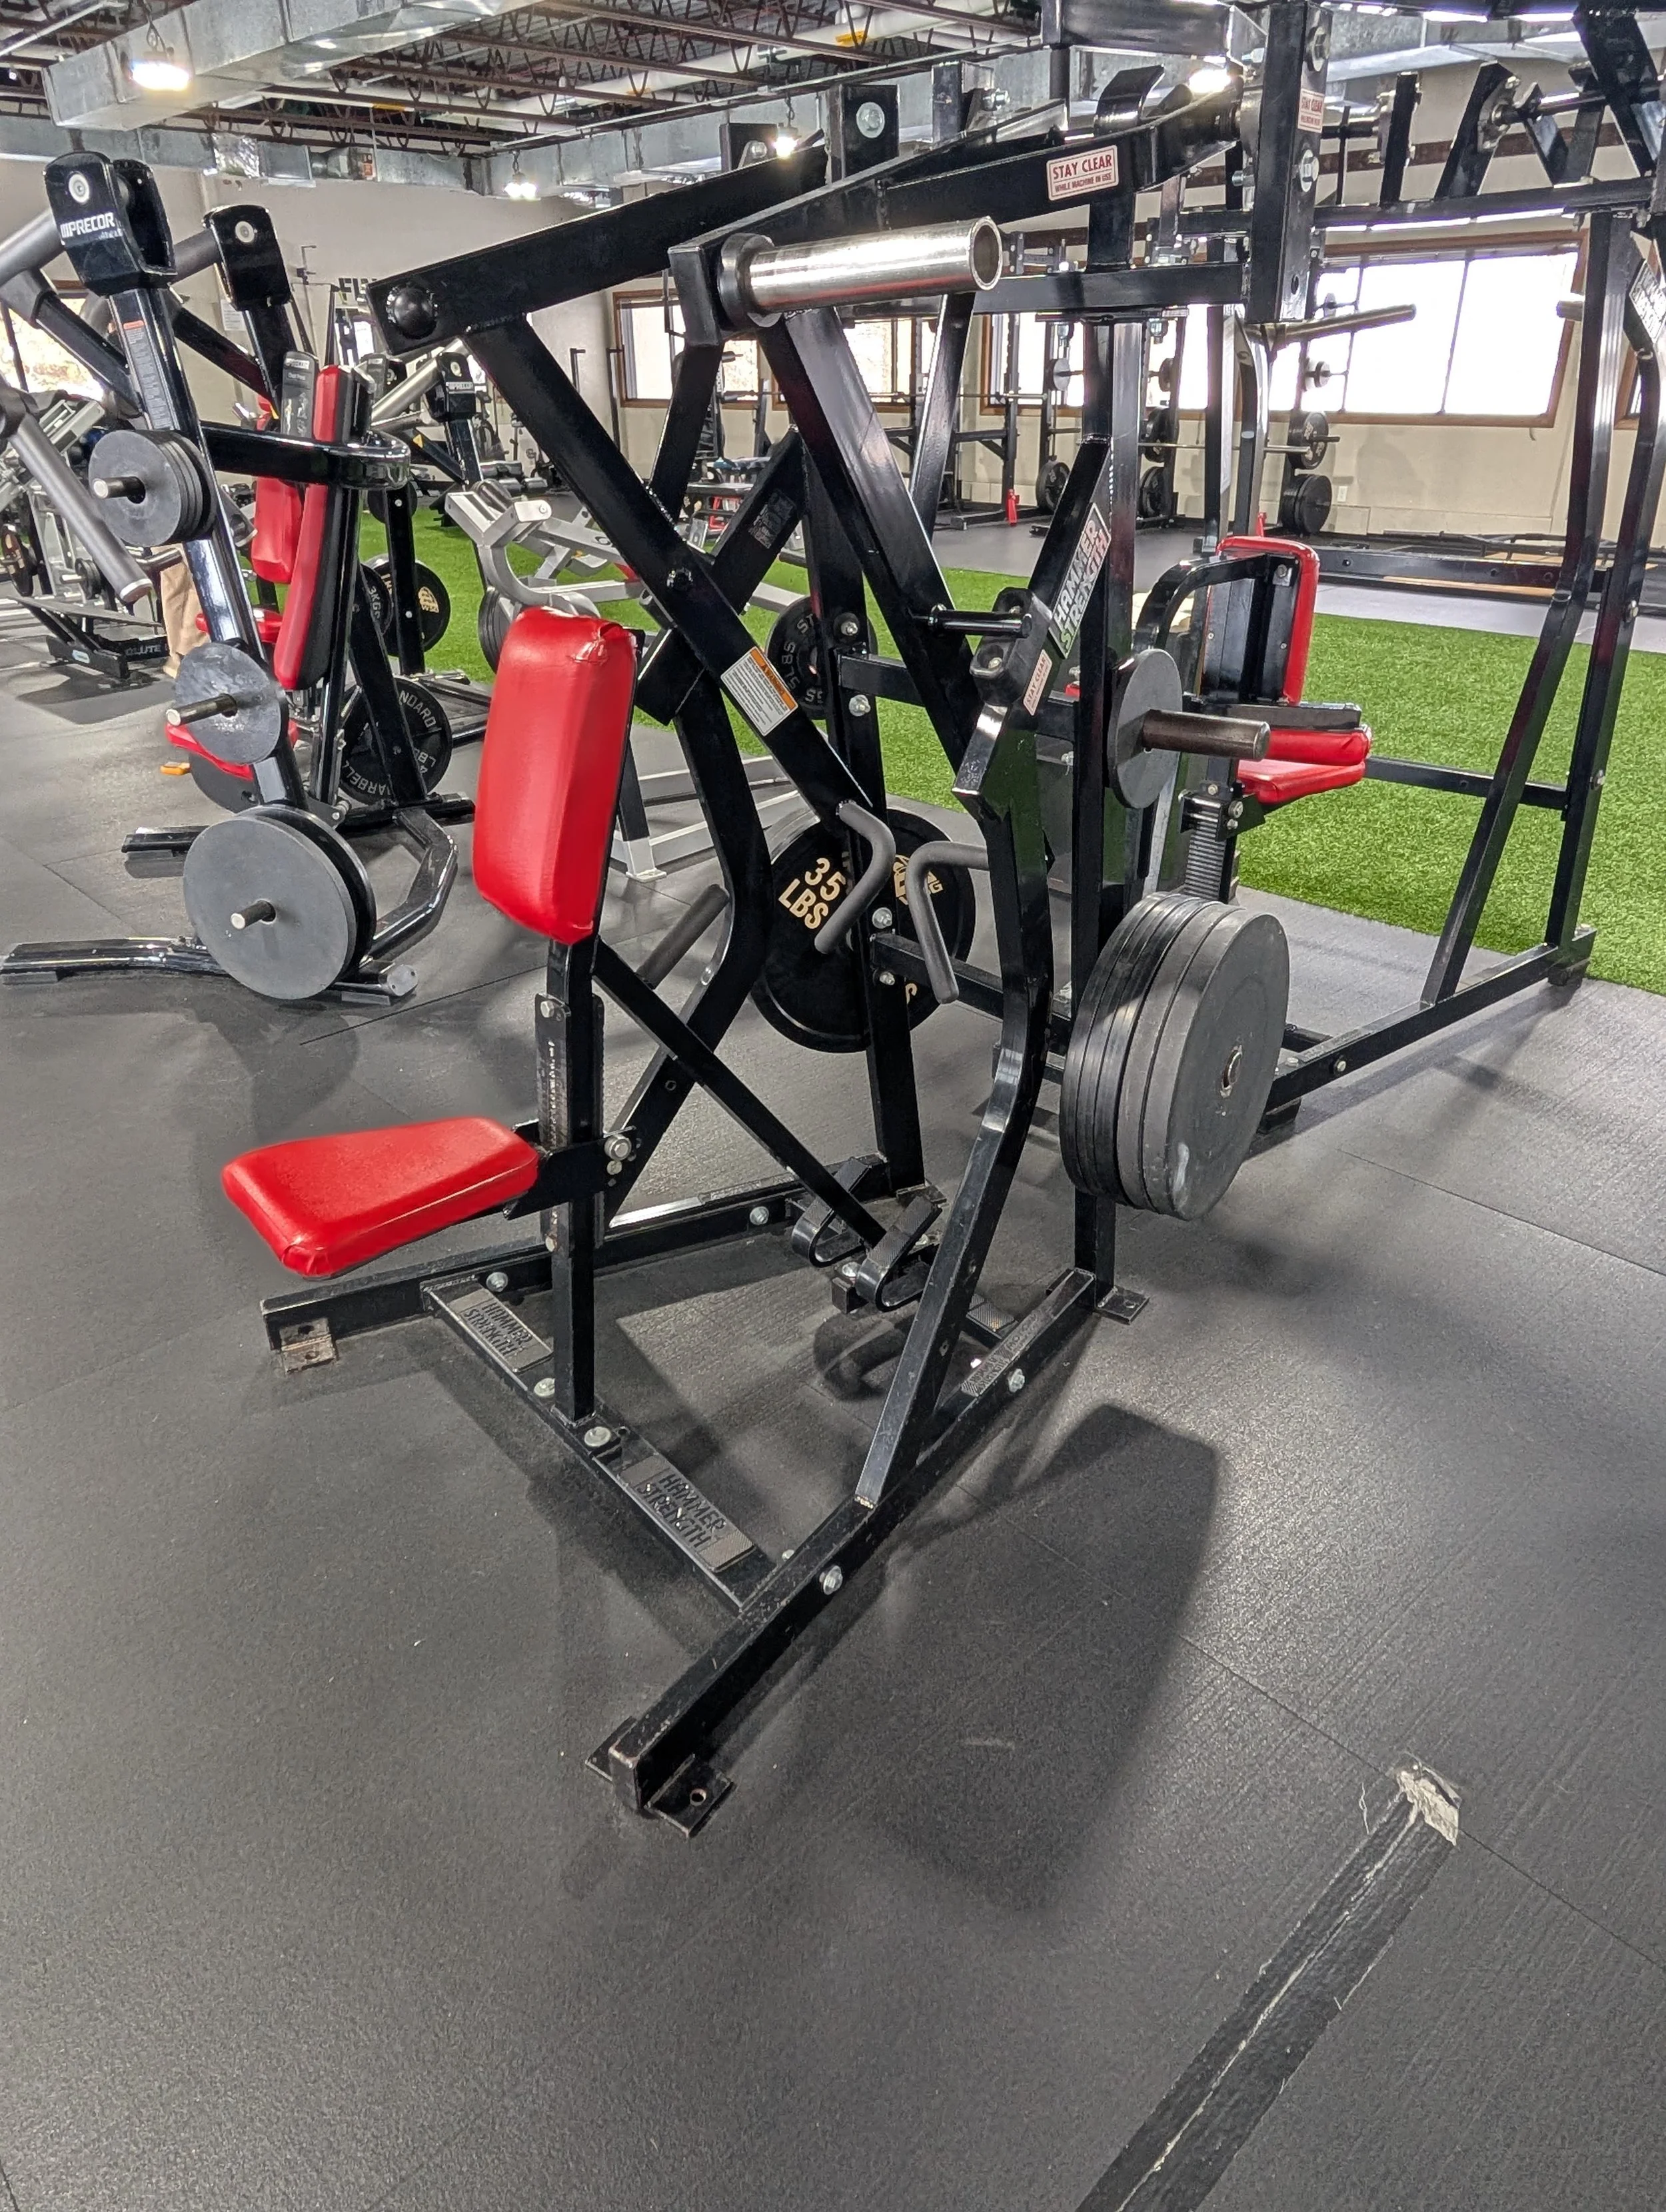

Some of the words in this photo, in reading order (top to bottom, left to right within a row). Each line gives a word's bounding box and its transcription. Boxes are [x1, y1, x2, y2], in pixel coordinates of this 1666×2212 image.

[1053, 162, 1078, 180] STAY
[1082, 155, 1112, 173] CLEAR
[69, 213, 115, 237] PRECOR
[1054, 520, 1098, 628] HAMMER
[1061, 529, 1108, 650] STRENGTH
[1027, 682, 1036, 703] STAY
[1035, 656, 1046, 682] CLEAR
[804, 857, 846, 901] 35
[778, 878, 828, 929] LBS
[464, 1309, 518, 1357] STRENGTH
[482, 1302, 532, 1345] HAMMER
[637, 1482, 712, 1548] STRENGTH
[658, 1474, 725, 1530] HAMMER
